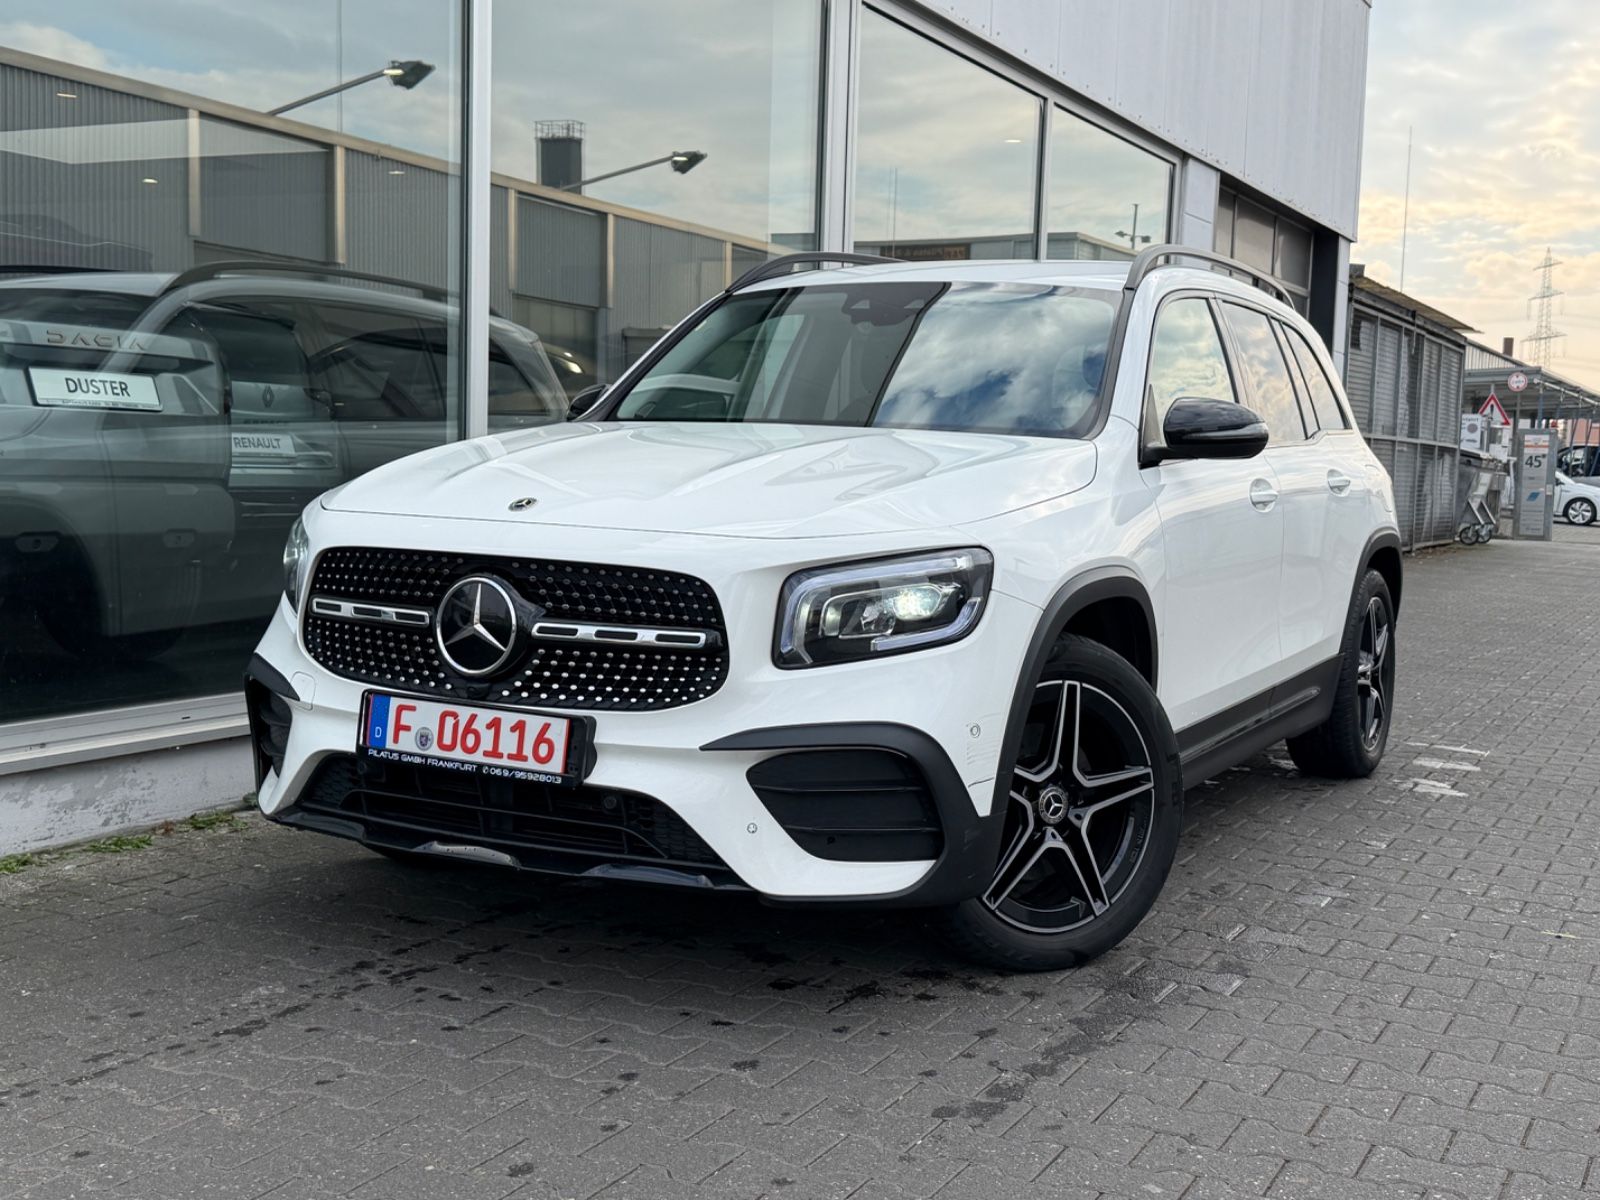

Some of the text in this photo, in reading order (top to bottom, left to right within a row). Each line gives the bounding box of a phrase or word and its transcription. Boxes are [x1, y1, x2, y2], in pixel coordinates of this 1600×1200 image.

[46, 329, 145, 351] DACIA
[65, 377, 131, 397] DUSTER
[233, 436, 281, 449] RENAULT
[374, 726, 382, 738] D
[392, 704, 556, 765] F 06116
[368, 748, 400, 761] PILATUS
[400, 754, 426, 764] GMBH
[427, 758, 478, 773] FRANKFURT
